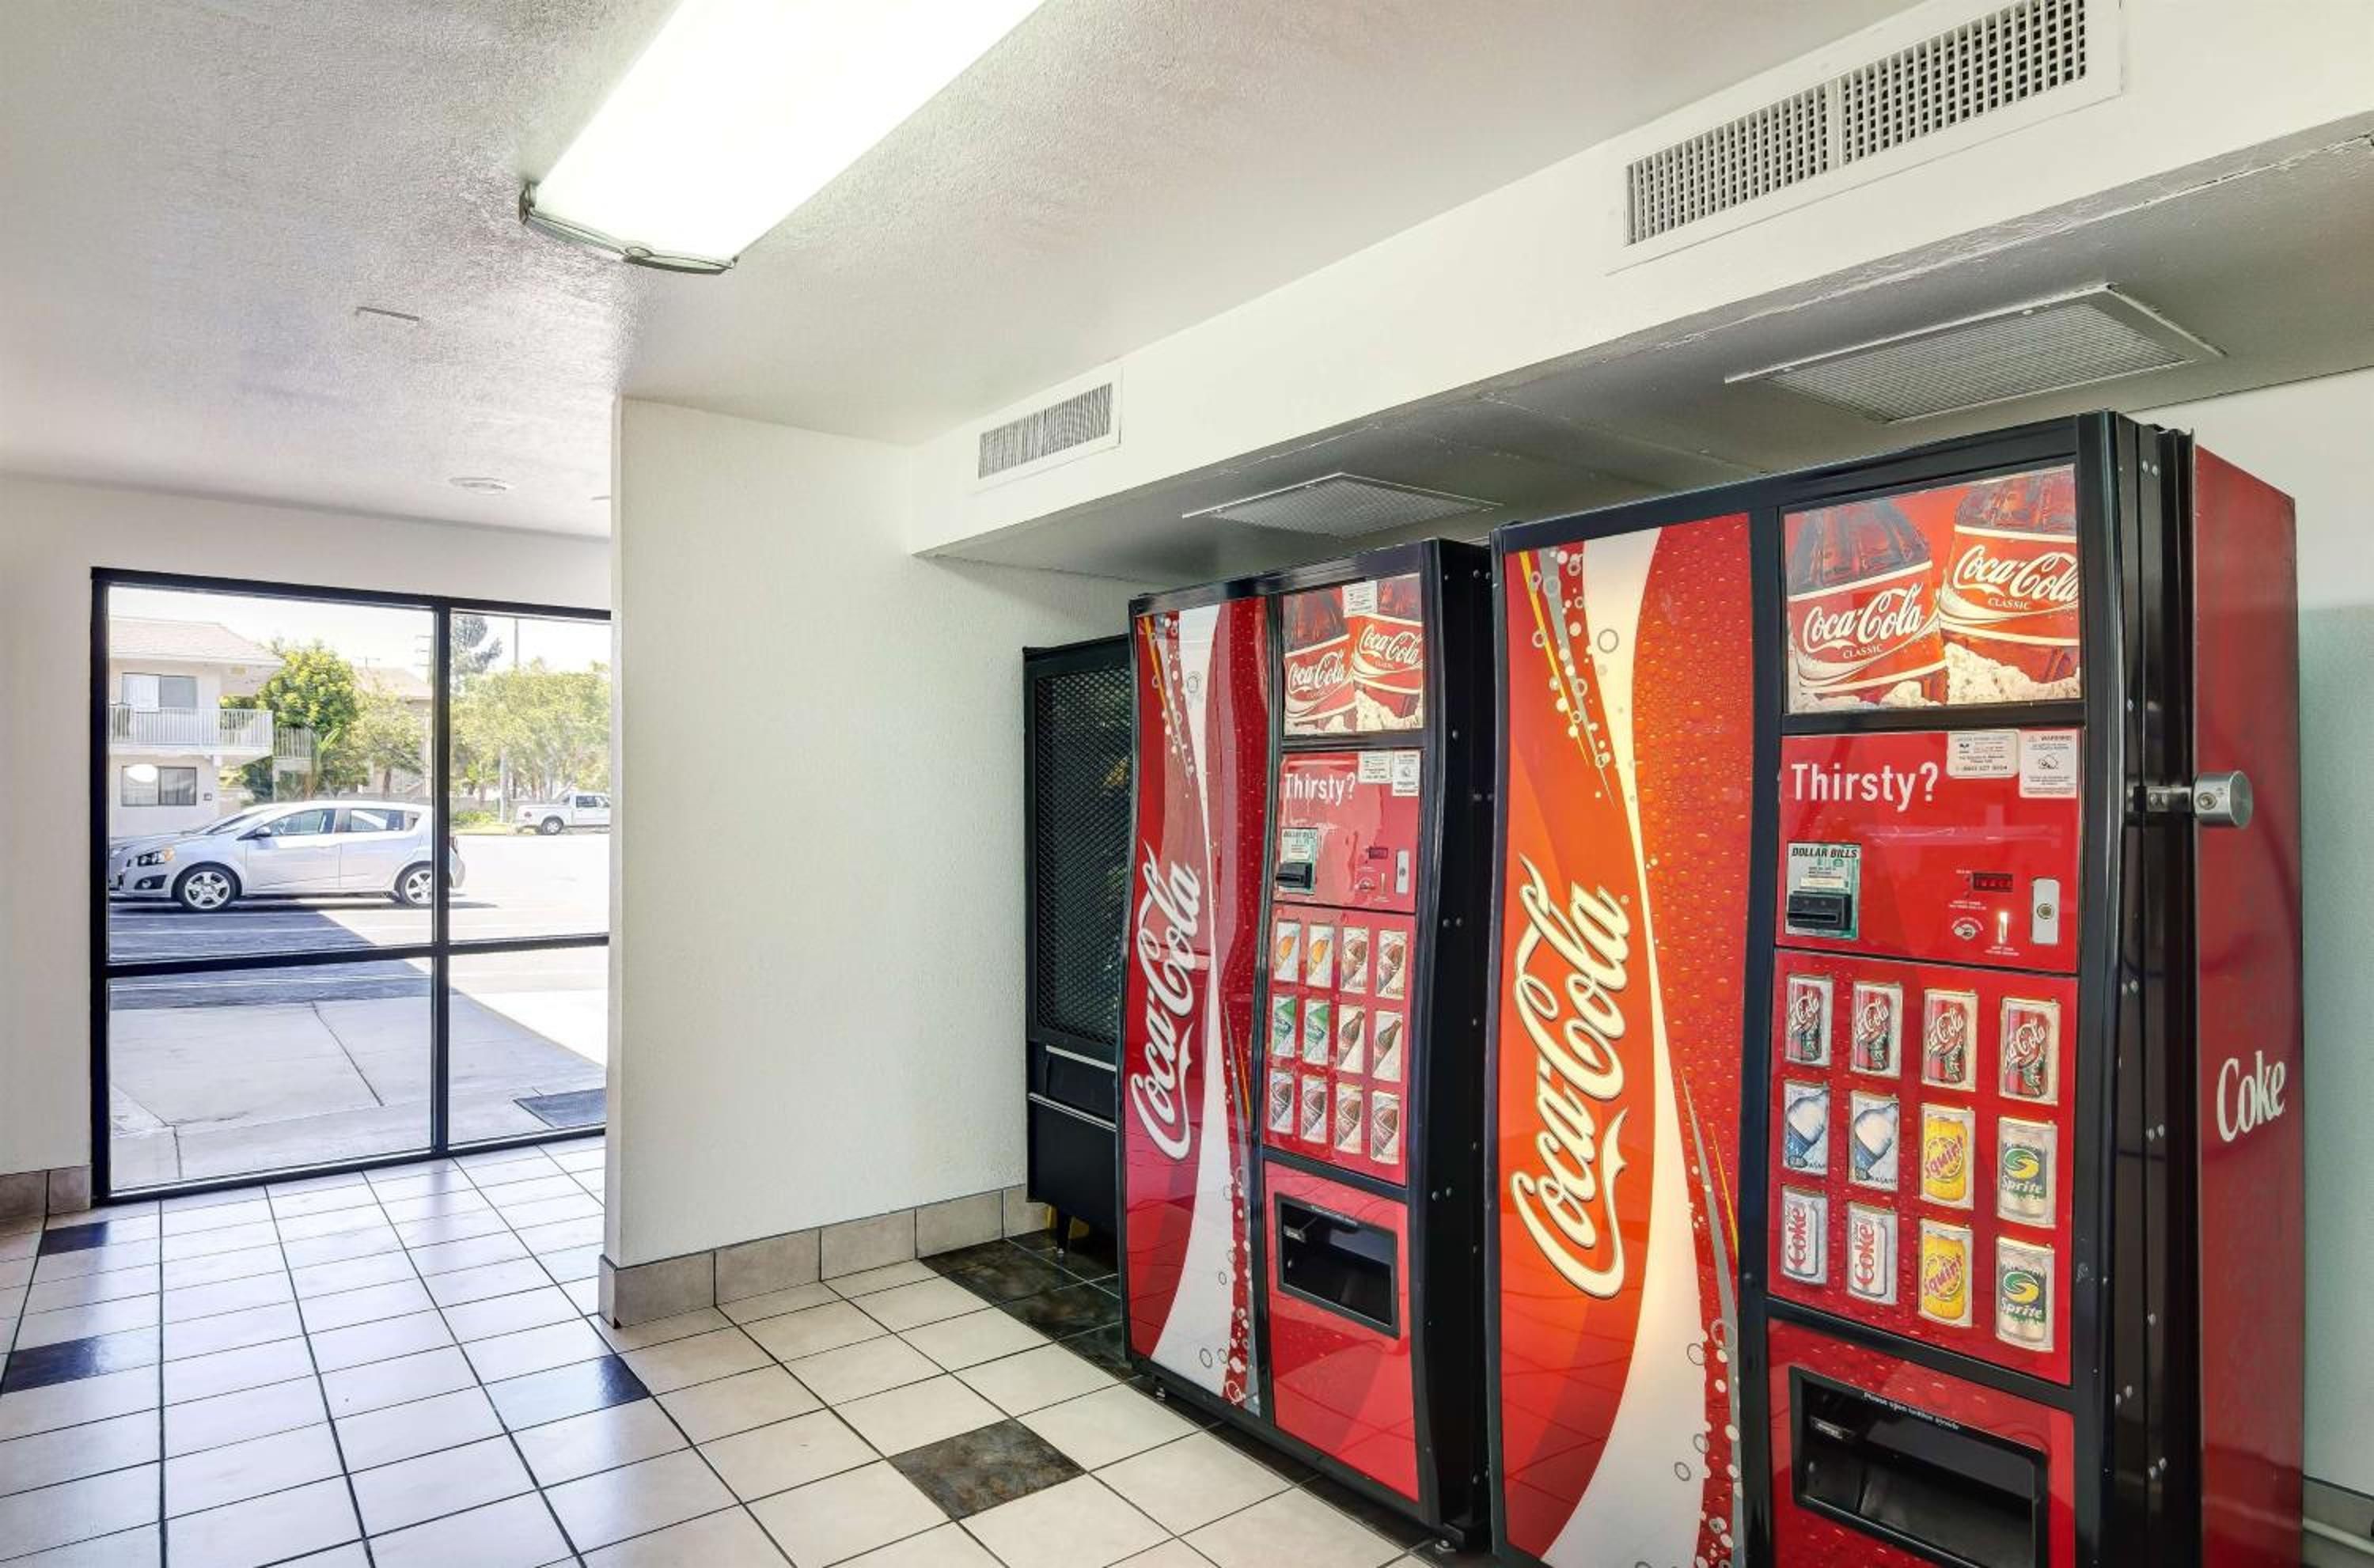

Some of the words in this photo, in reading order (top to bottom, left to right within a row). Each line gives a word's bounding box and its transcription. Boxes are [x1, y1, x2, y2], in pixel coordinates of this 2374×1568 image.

[1952, 544, 2078, 601] Coca-Cola
[1803, 583, 1925, 653] Coca-Cola
[1989, 597, 2031, 610] CLASSIC
[1359, 623, 1423, 665] Coca-Cola
[1843, 645, 1883, 659] CLASSIC
[1288, 649, 1345, 694] Coca-Cola
[1284, 772, 1356, 806] Thirsty?
[1791, 761, 1939, 812] Thirsty?
[1792, 847, 1827, 857] DOLLAR
[1830, 849, 1857, 858] BILLS
[1131, 840, 1201, 1160] Coca-Cola
[1511, 853, 1630, 1298] Coca-Cola
[2217, 1050, 2286, 1142] Coke
[2000, 1175, 2042, 1195] Sprite
[1854, 1224, 1875, 1286] Coke
[2000, 1296, 2042, 1318] Sprite
